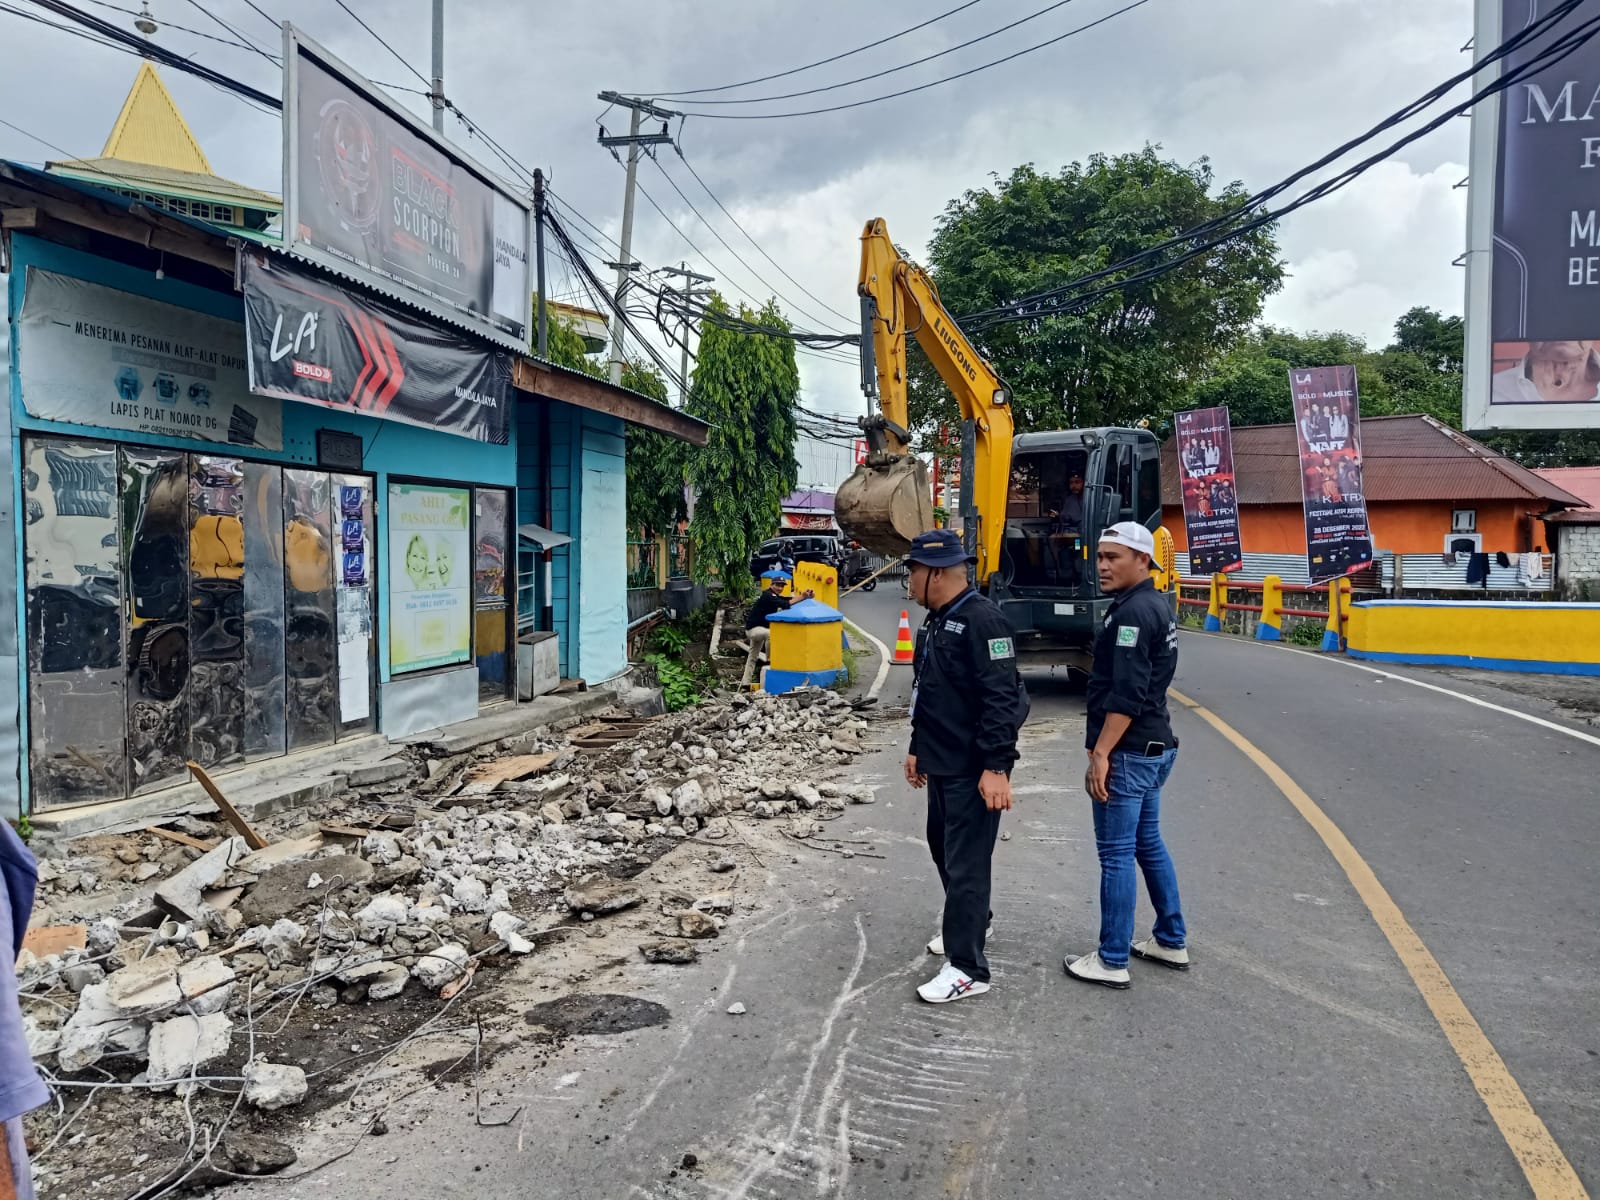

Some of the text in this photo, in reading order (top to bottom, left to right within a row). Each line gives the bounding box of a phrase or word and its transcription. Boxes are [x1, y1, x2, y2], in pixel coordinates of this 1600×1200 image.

[392, 156, 460, 229] BLACK
[393, 196, 460, 260] SCORPION
[1570, 210, 1600, 247] M
[495, 237, 527, 264] MANDALA
[495, 251, 511, 270] JAYA
[1568, 256, 1599, 286] BE
[75, 321, 127, 345] MENERIMA
[131, 333, 171, 354] PESANAN
[174, 343, 218, 365] ALAT-ALAT
[221, 354, 246, 370] DAPUR
[934, 317, 977, 382] LIUGONG
[296, 363, 323, 378] BOLD
[455, 385, 497, 408] MANDALA JAYA
[1322, 390, 1353, 398] MUSIC
[111, 401, 138, 418] LAPIS
[144, 407, 165, 421] PLAT
[170, 411, 201, 426] NOMOR
[1309, 440, 1346, 455] NAFF
[1188, 466, 1218, 479] NAFF
